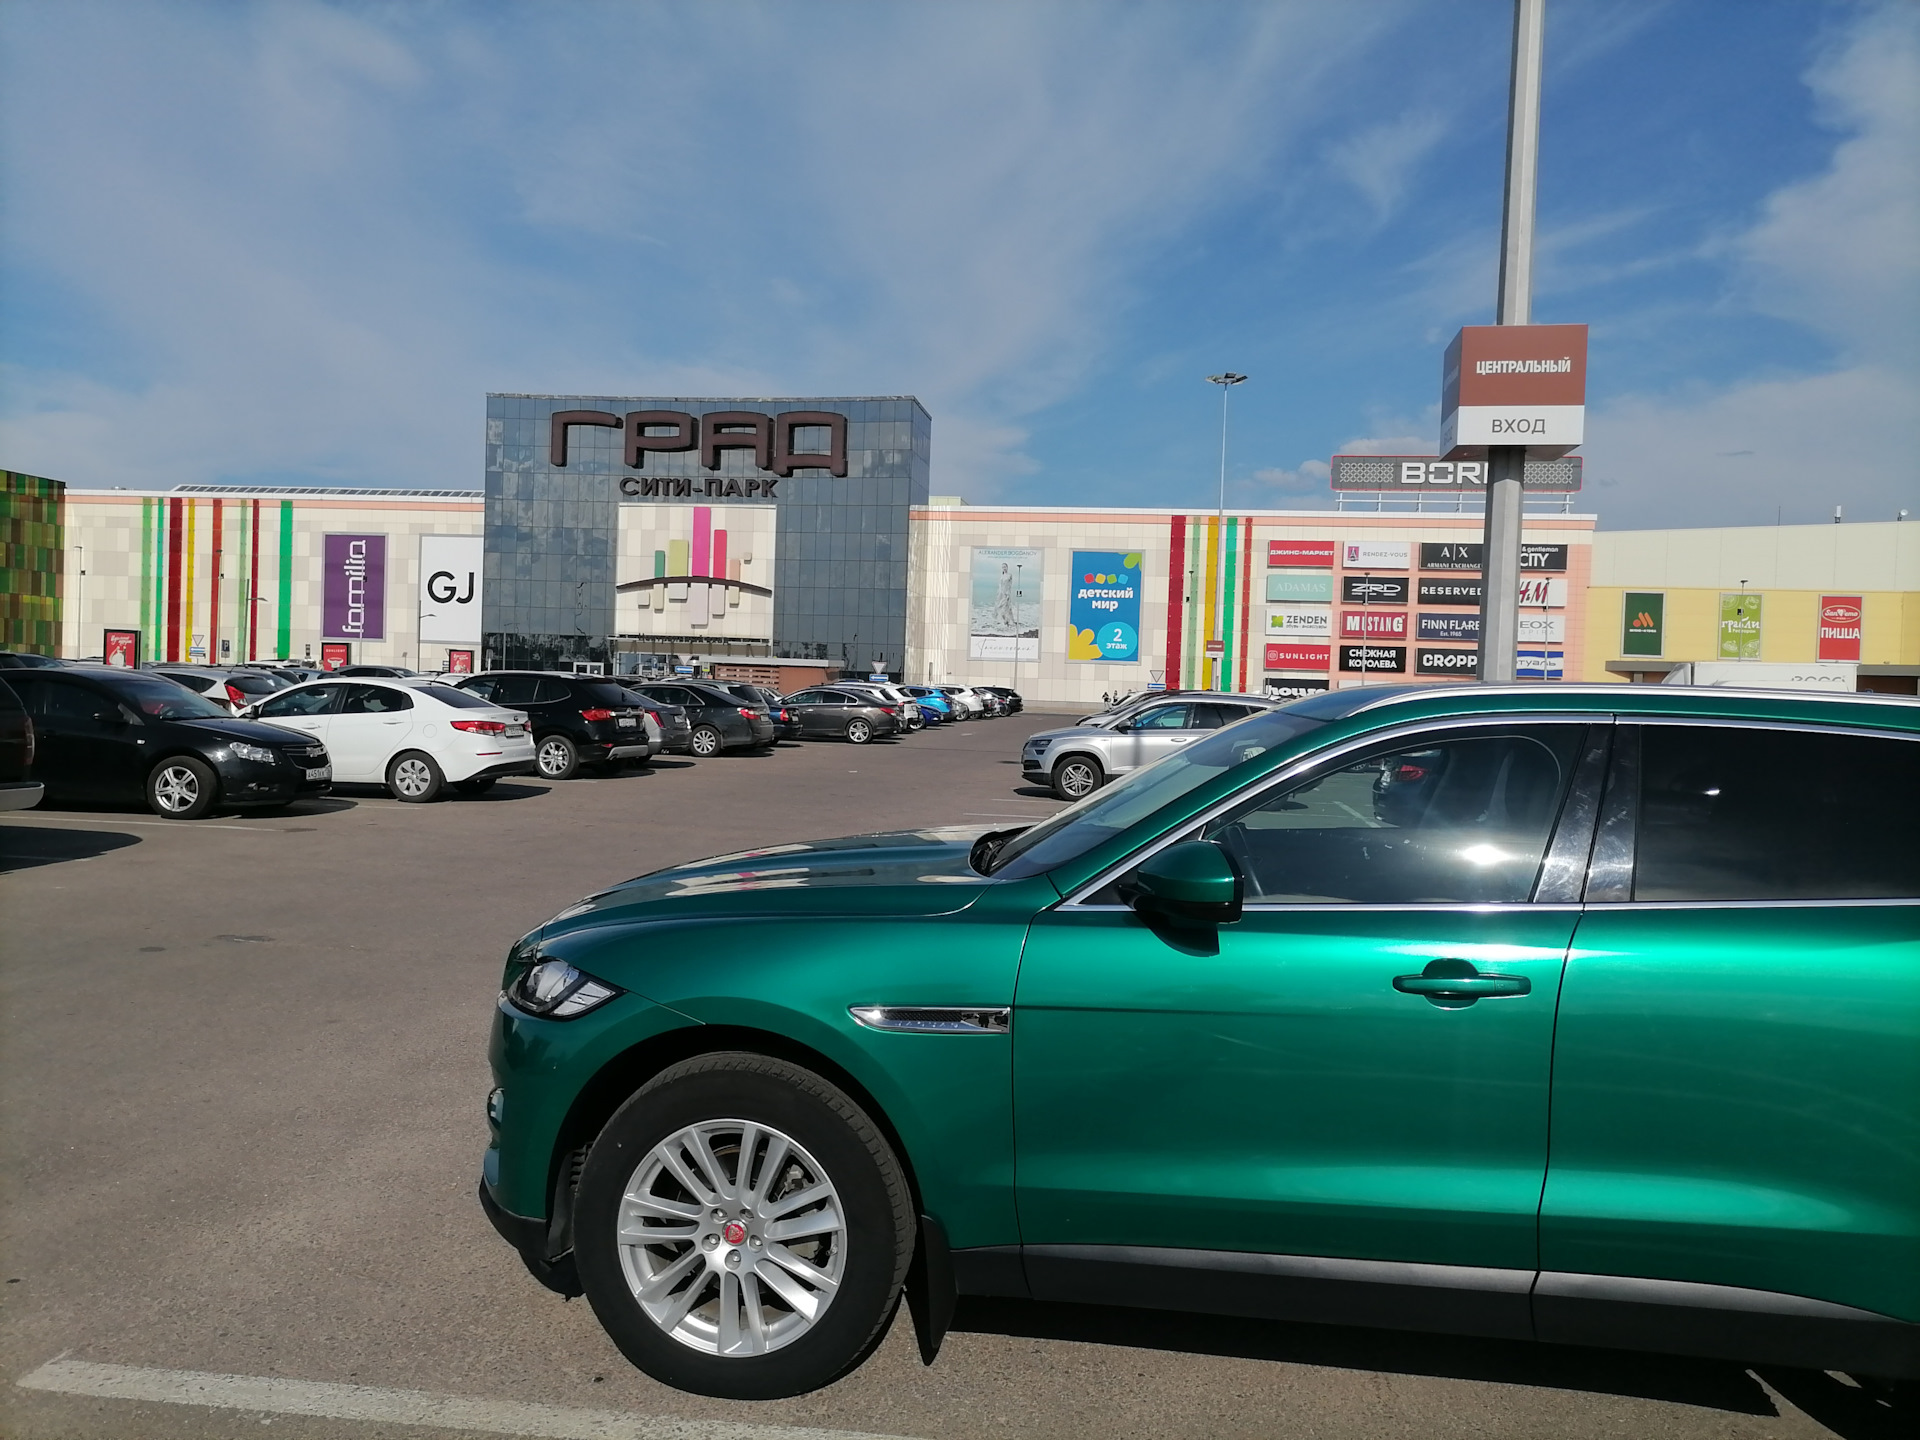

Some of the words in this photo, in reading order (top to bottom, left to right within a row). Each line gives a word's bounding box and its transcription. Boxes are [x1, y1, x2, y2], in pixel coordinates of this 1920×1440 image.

[1476, 357, 1571, 375] ЦЕНТРАЛЬНЫЙ
[1492, 419, 1545, 435] ВХОД
[551, 411, 848, 477] ГРАД
[619, 477, 778, 498] СИТИ-ПАРК
[1520, 553, 1549, 567] CITY
[342, 539, 366, 633] familia
[427, 571, 475, 604] GJ
[1275, 582, 1326, 593] ADAMAS
[1078, 587, 1134, 599] детский
[1092, 600, 1118, 612] мир
[1286, 615, 1327, 625] ZENDEN
[1346, 615, 1403, 632] MUSTANG
[1422, 619, 1447, 629] FINN
[1450, 620, 1480, 631] FLARE
[1520, 620, 1554, 629] EOX
[1113, 628, 1122, 642] 2
[1821, 627, 1860, 639] ПИЦЦА
[1279, 652, 1329, 660] SUNLIGHT
[1349, 649, 1396, 658] СНЕЖНАЯ
[1349, 659, 1397, 669] КОРОЛЕВА
[1422, 654, 1478, 668] CROPP
